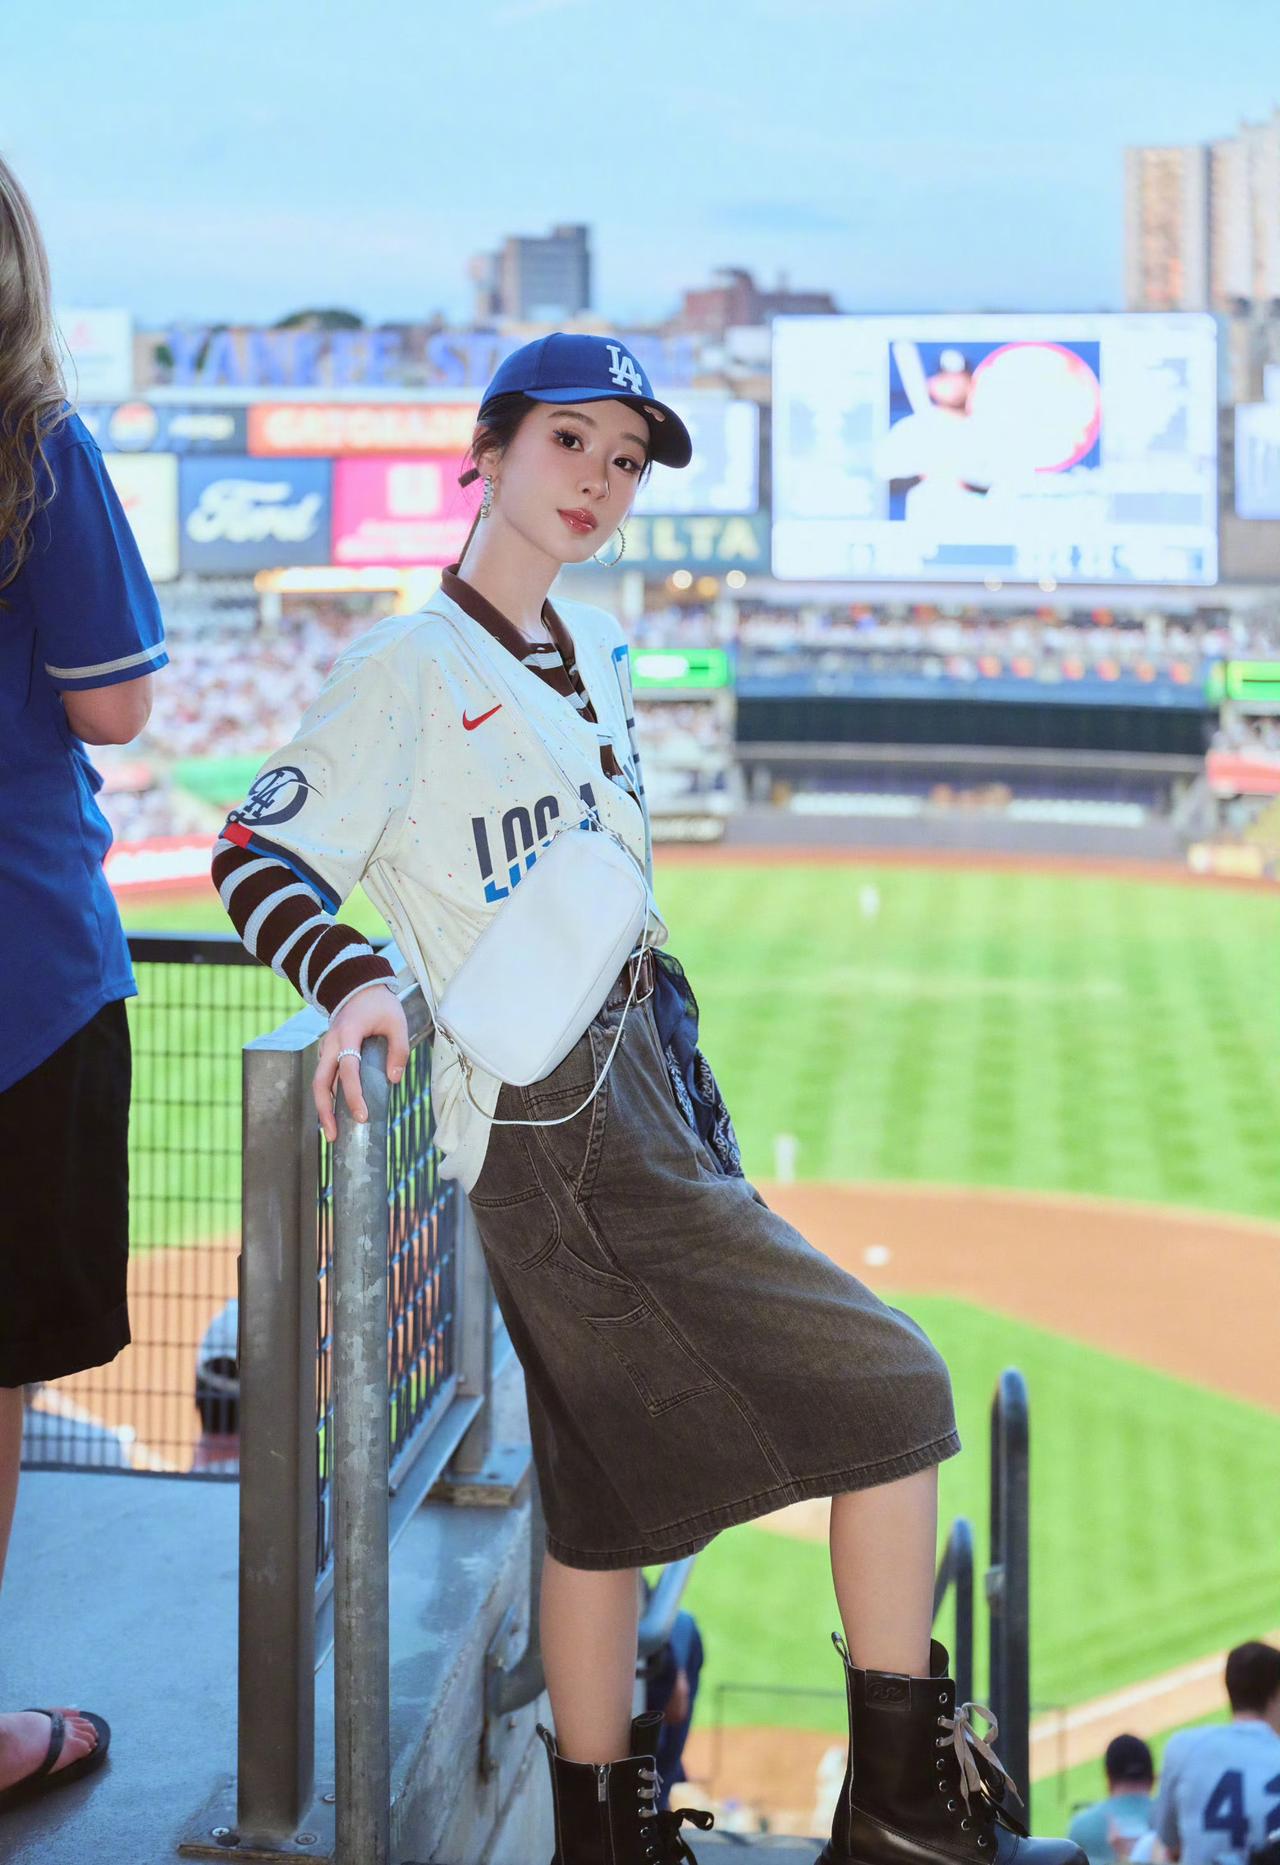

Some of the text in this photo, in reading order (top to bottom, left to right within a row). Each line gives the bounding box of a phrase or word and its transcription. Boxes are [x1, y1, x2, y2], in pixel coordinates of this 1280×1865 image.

[606, 345, 643, 395] LA
[187, 479, 322, 542] Ford
[618, 516, 761, 561] ELTA
